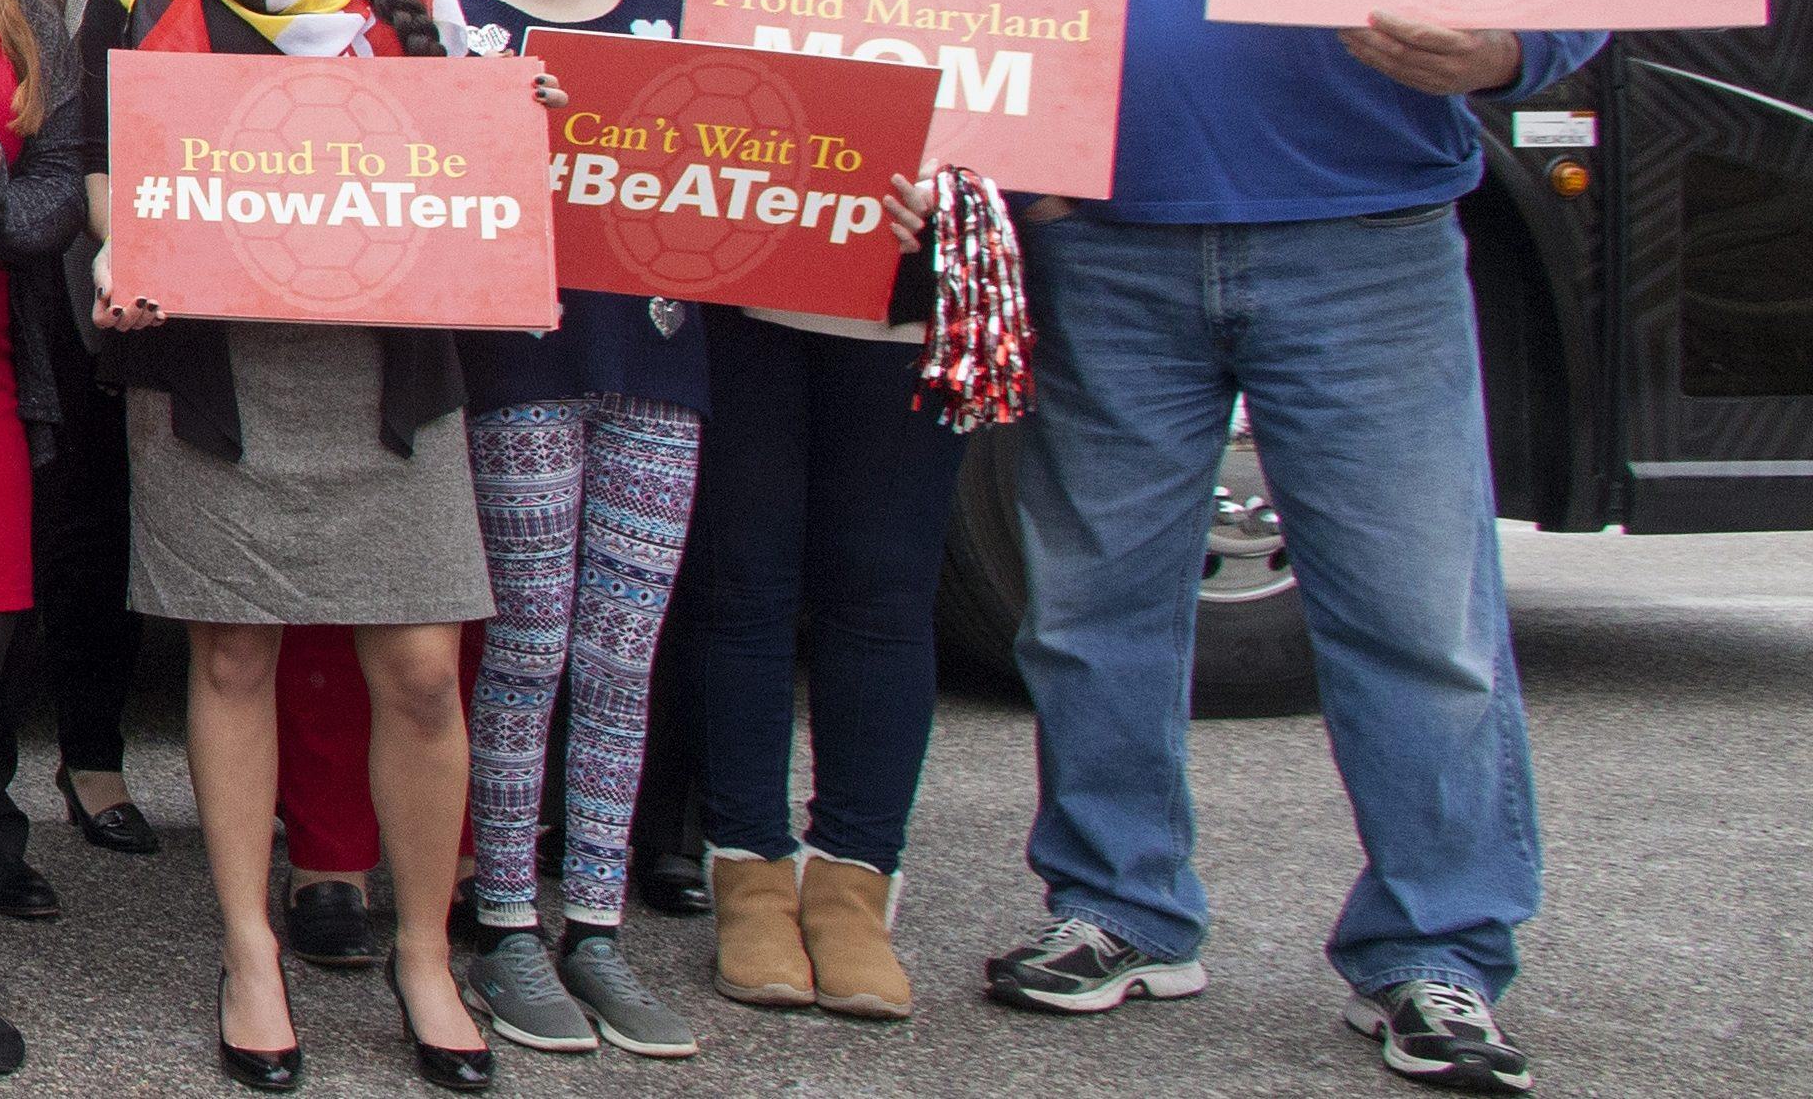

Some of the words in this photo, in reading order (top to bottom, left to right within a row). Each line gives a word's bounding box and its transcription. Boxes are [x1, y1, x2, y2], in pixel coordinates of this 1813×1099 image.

[180, 138, 316, 176] Proud
[326, 141, 387, 178] To
[404, 143, 467, 179] Be
[562, 111, 680, 154] Can't
[693, 122, 796, 165] Wait
[808, 134, 863, 173] To
[133, 175, 521, 240] #NowATerp
[548, 152, 883, 245] #BeATerp
